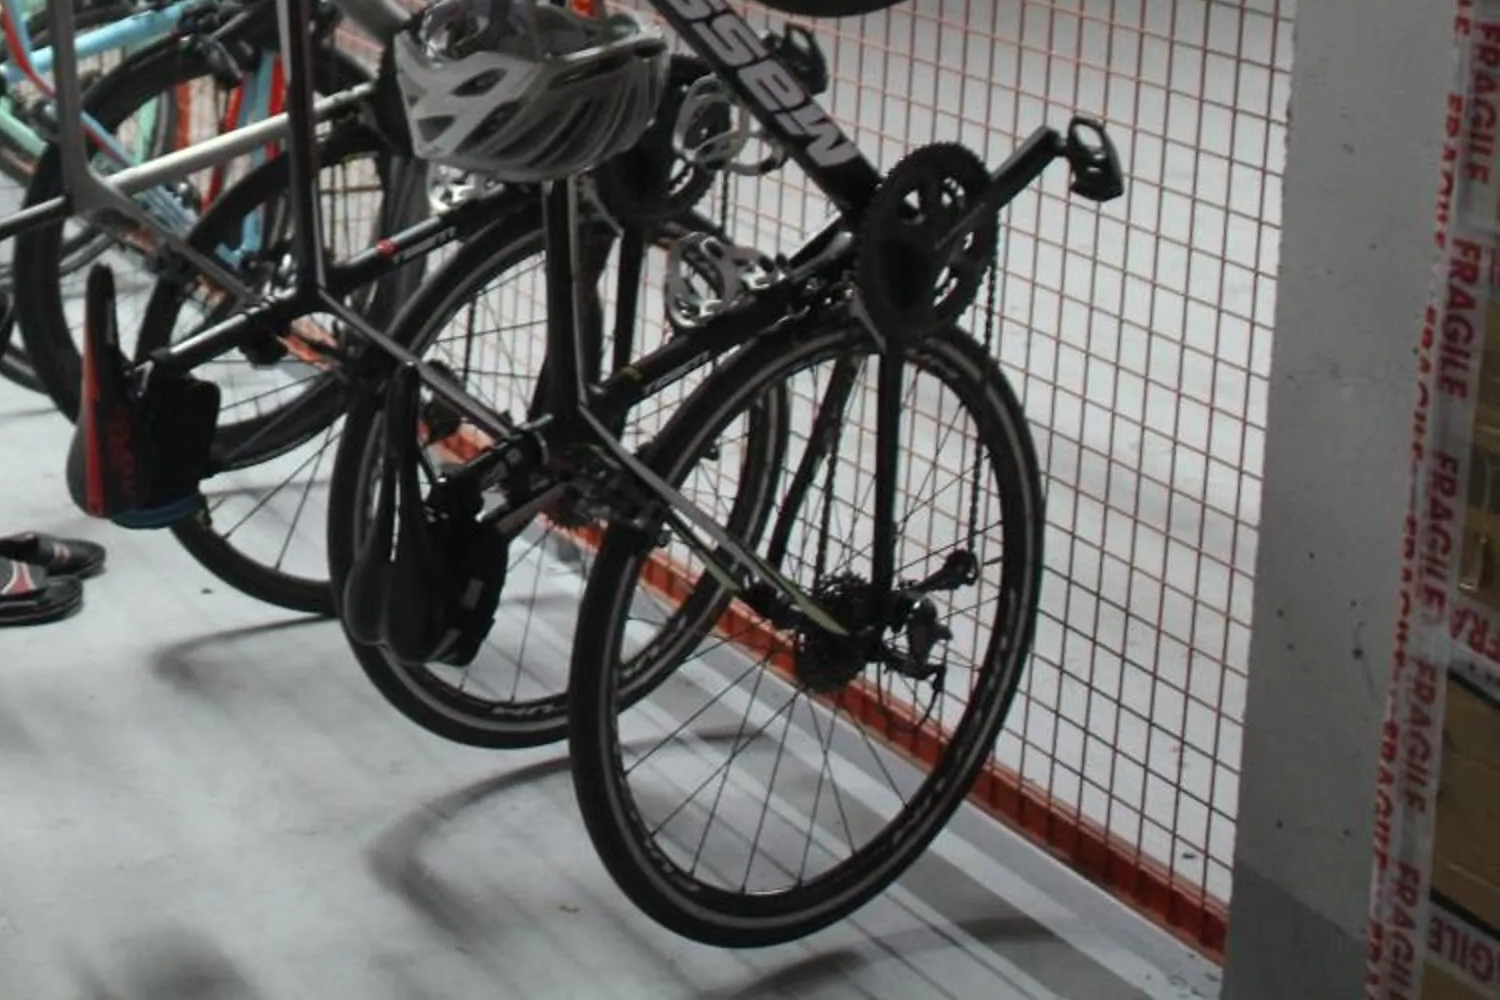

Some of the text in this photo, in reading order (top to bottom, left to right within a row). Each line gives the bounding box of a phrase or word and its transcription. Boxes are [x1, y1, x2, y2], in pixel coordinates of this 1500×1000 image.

[1442, 236, 1482, 399] FRAGILE
[1422, 450, 1460, 609] FRAGILE
[1404, 656, 1437, 814] FRAGILE
[1428, 913, 1500, 983] GILE
